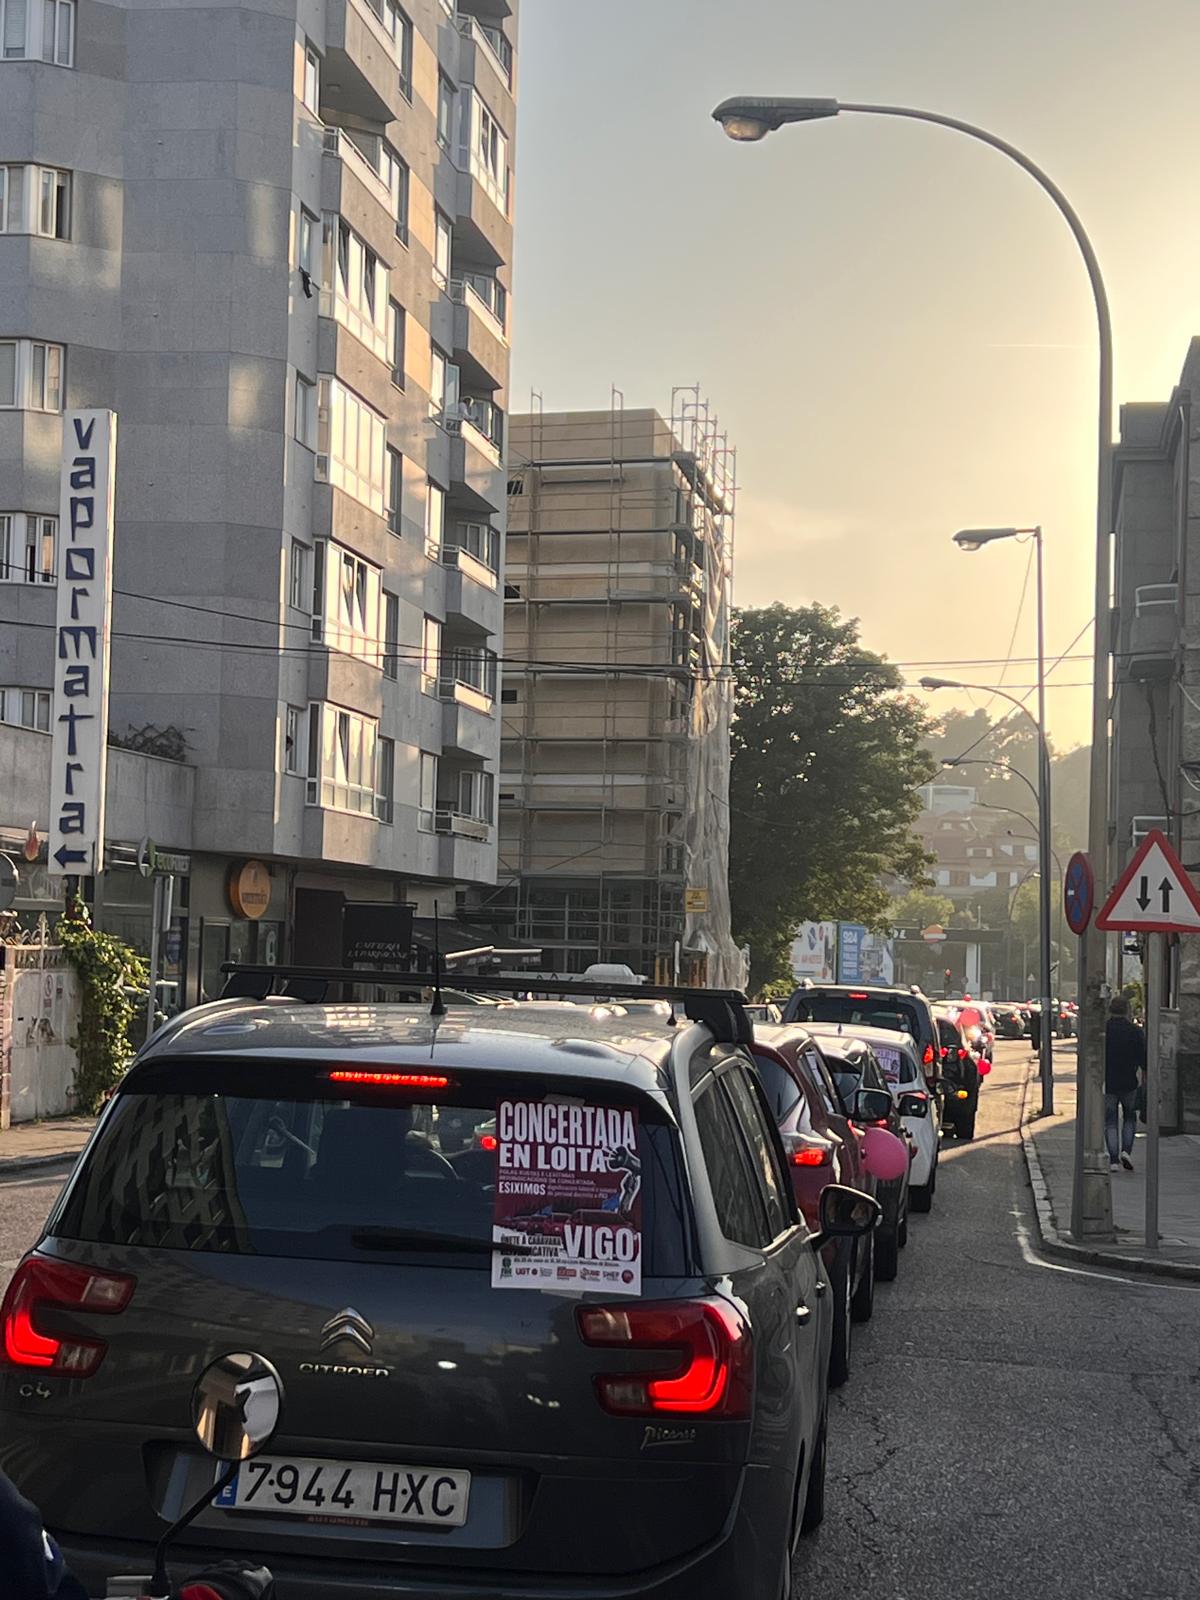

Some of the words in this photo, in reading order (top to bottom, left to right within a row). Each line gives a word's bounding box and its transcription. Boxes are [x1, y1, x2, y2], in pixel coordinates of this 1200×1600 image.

[58, 416, 97, 835] vapormatra
[499, 1101, 636, 1150] CONCERTADA
[499, 1143, 530, 1168] EN
[537, 1145, 607, 1173] LOITA
[499, 1182, 546, 1196] ESIXIMOS
[564, 1224, 635, 1261] VIGO
[245, 1462, 354, 1509] 7944
[373, 1471, 457, 1517] HXC
